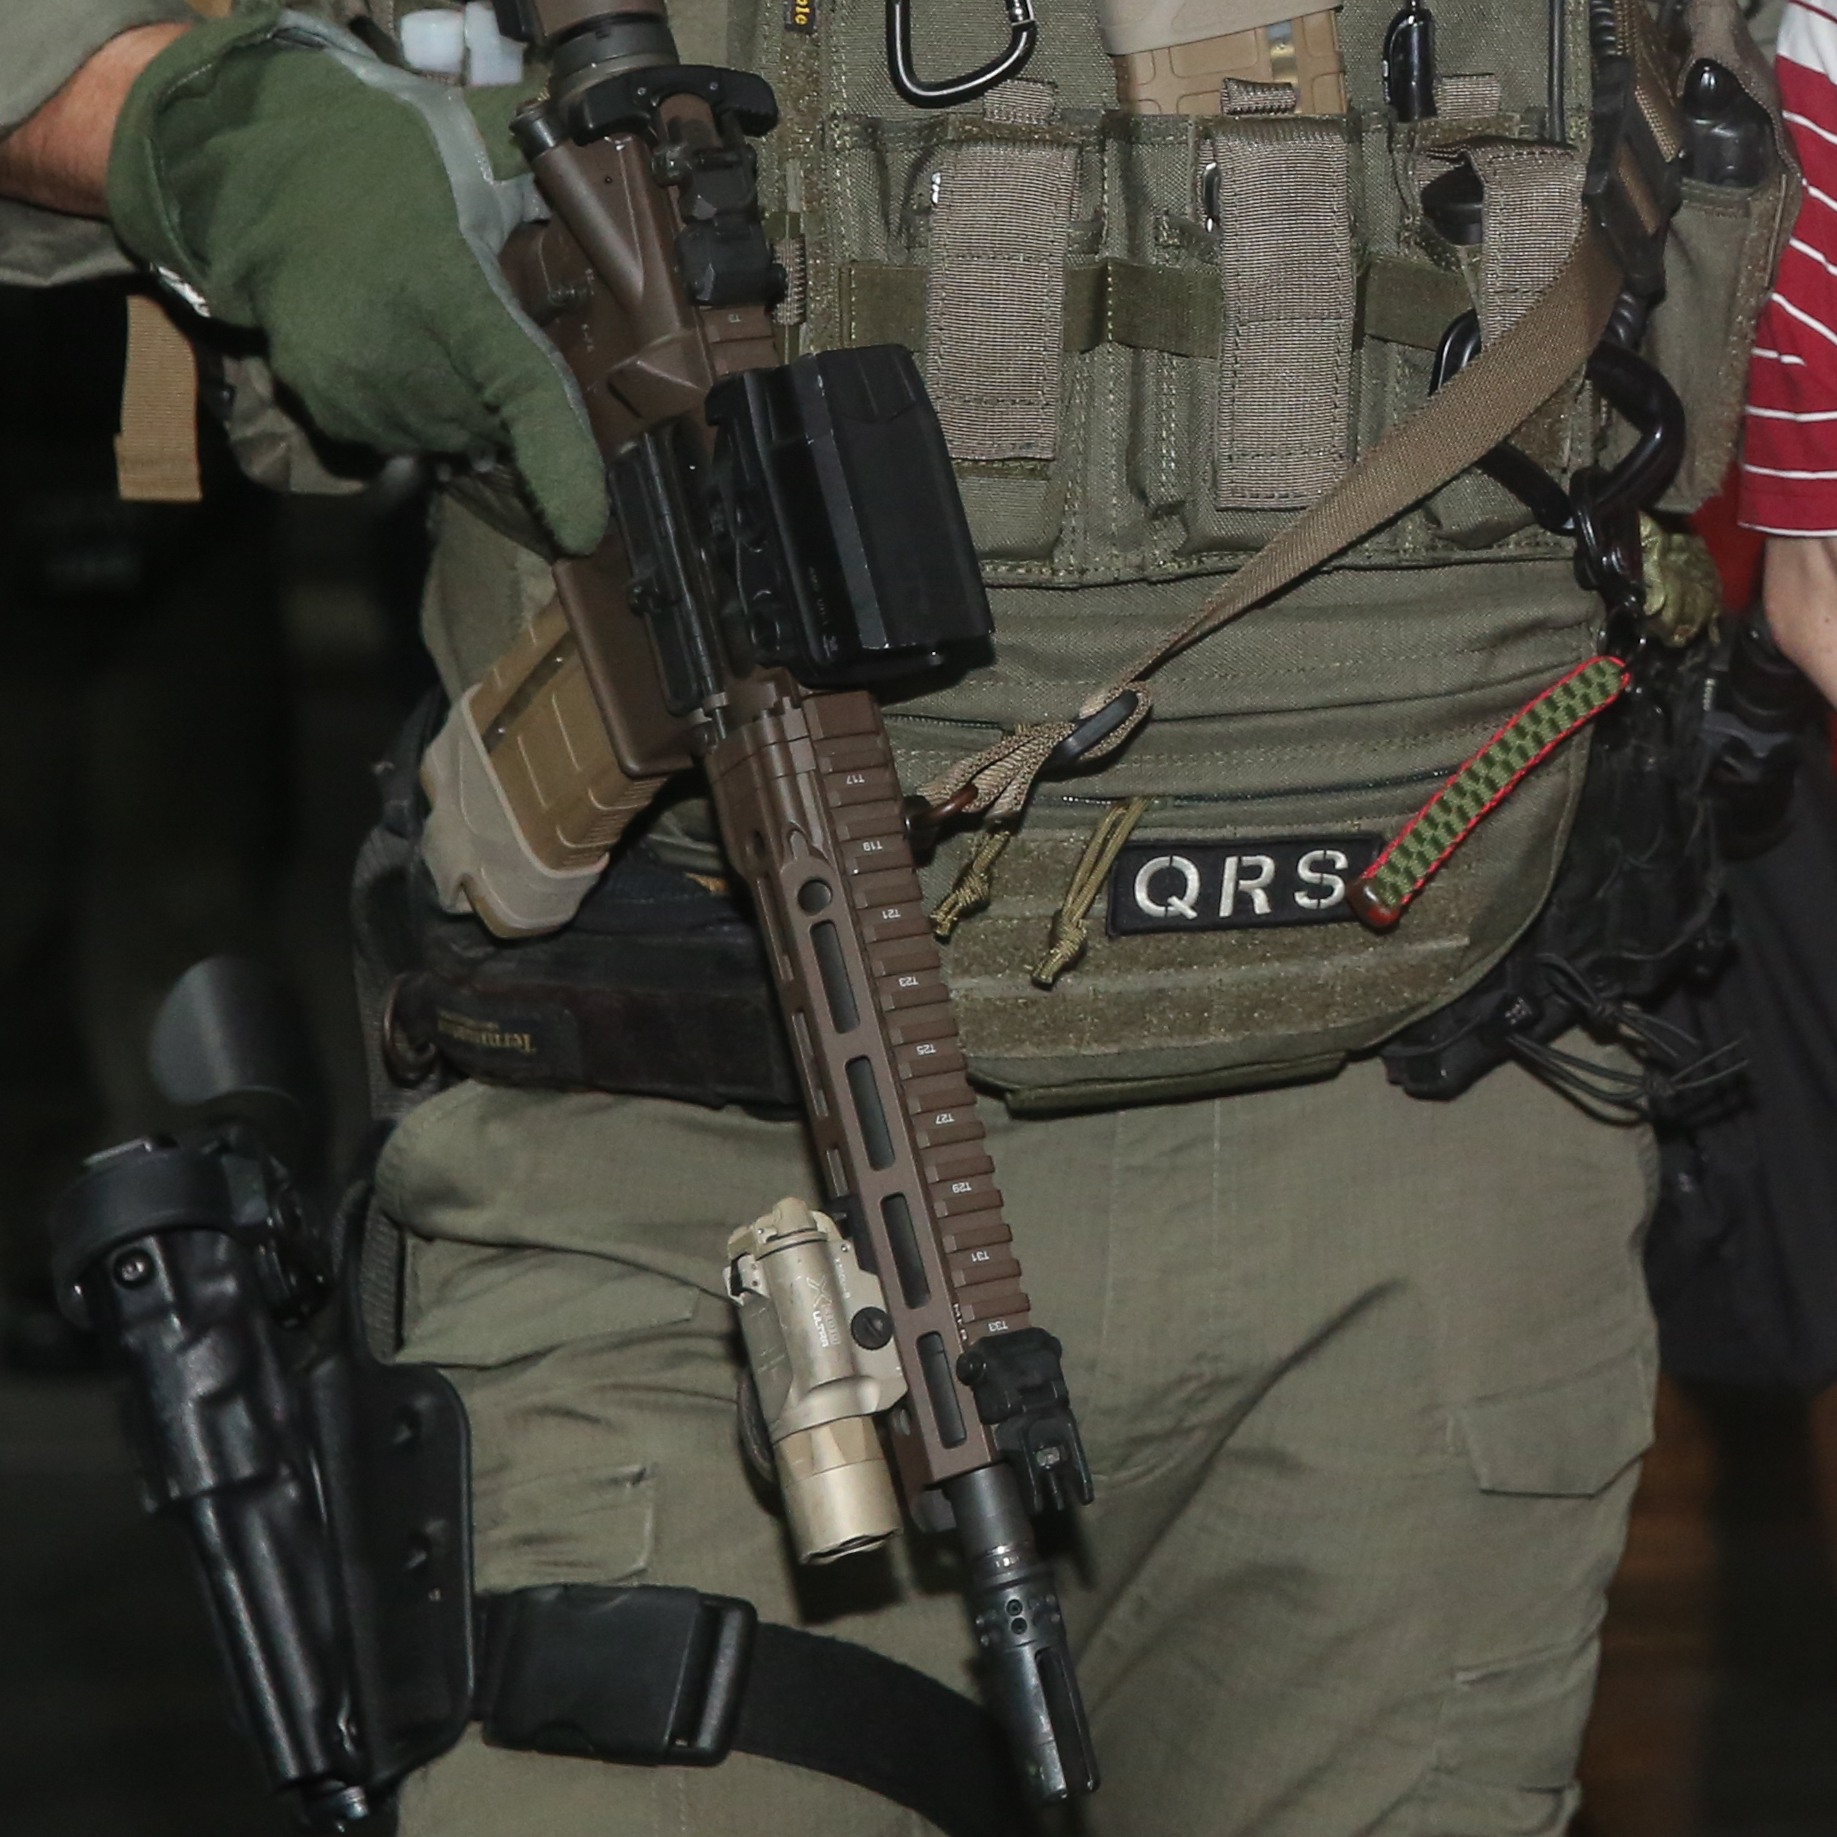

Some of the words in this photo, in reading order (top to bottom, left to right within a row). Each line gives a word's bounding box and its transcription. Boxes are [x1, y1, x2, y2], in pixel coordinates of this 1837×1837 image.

[846, 773, 866, 785] T17
[862, 840, 883, 851] T19
[1134, 849, 1348, 919] QRS
[881, 908, 902, 920] T21
[898, 976, 919, 987] T23
[916, 1043, 937, 1055] T25
[935, 1112, 956, 1125] T27
[951, 1181, 973, 1194] T29
[970, 1250, 991, 1263] T31
[812, 1310, 830, 1348] ULTRA
[987, 1319, 1010, 1333] T33
